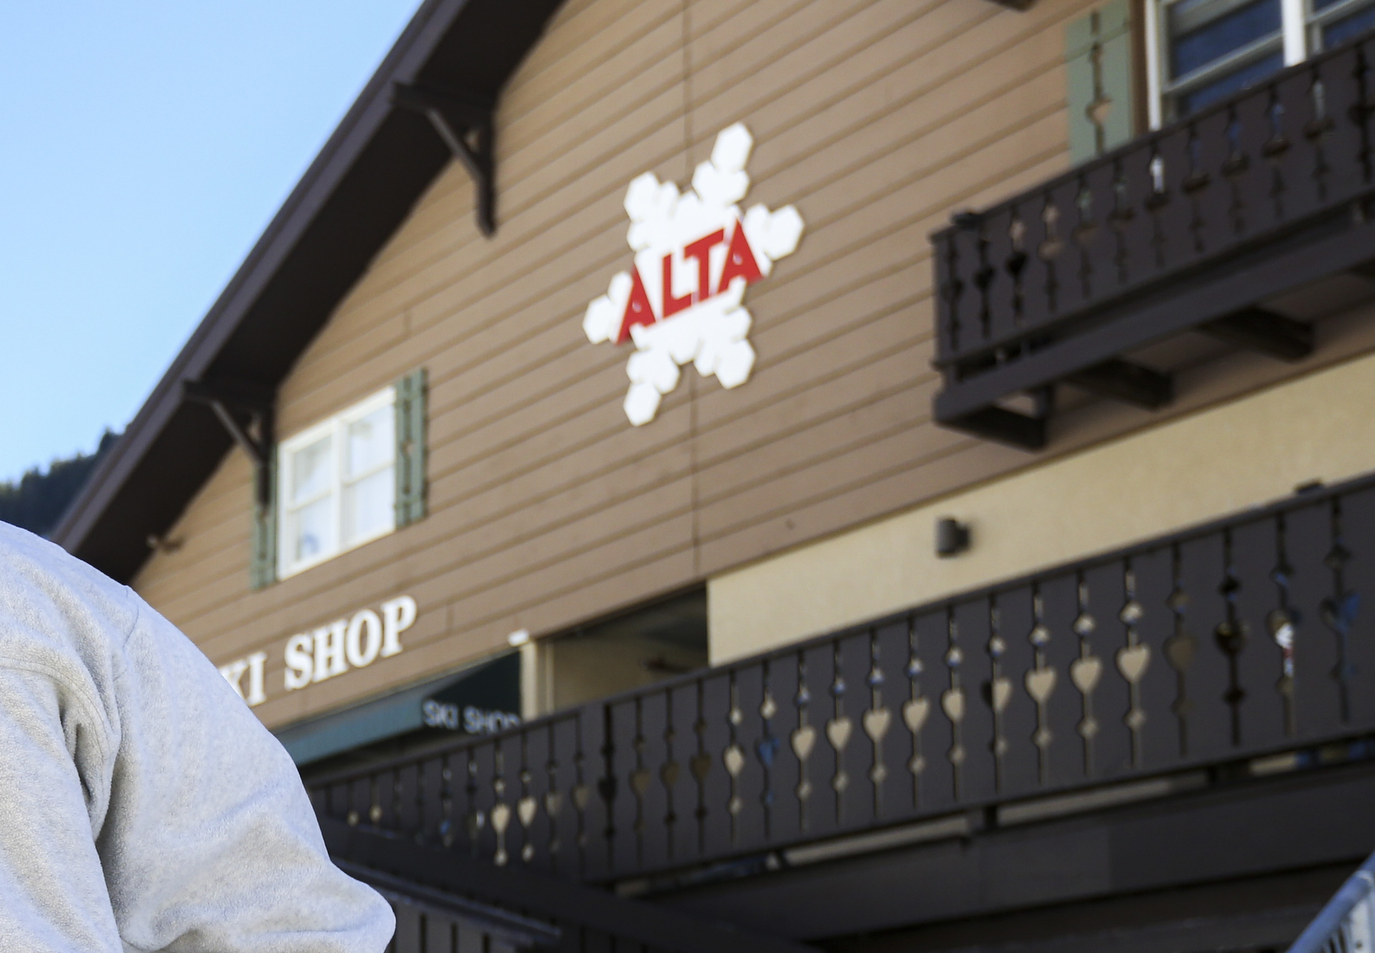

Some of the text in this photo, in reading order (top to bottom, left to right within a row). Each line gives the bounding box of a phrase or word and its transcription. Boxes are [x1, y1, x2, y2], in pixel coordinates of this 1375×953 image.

[615, 216, 764, 346] ALTA
[218, 595, 418, 707] KI SHOP
[423, 698, 459, 729] SKI
